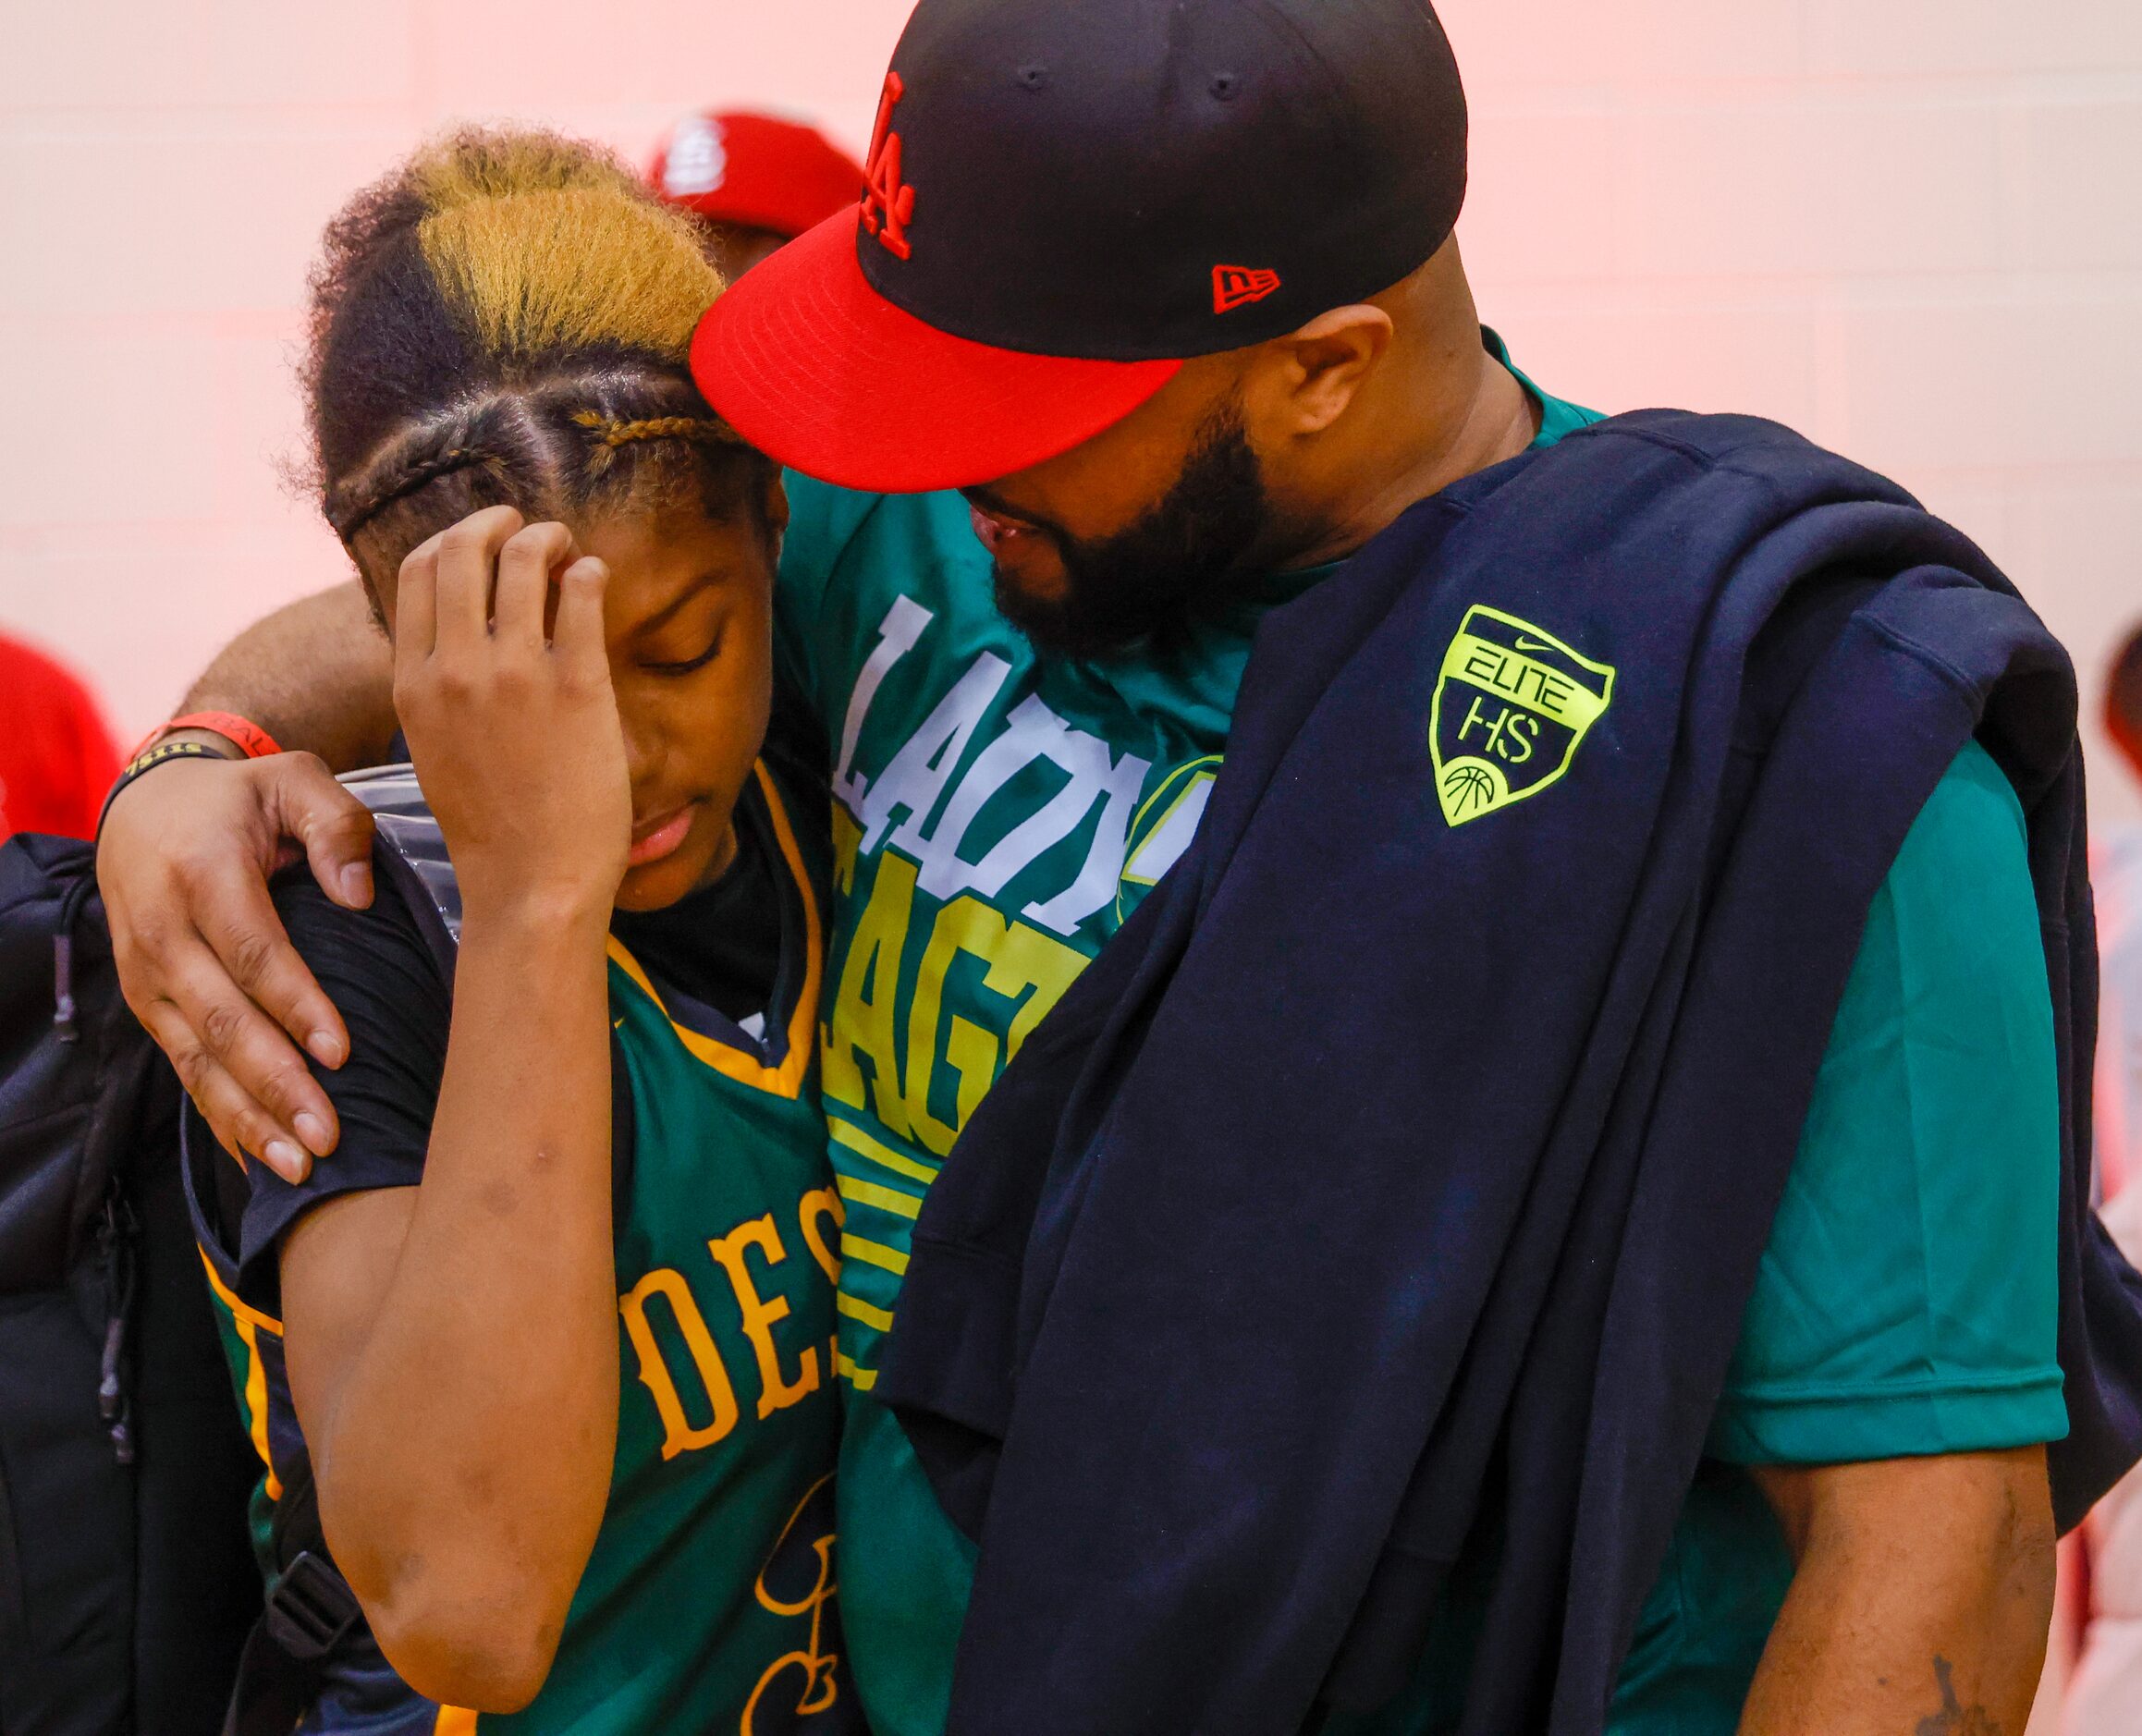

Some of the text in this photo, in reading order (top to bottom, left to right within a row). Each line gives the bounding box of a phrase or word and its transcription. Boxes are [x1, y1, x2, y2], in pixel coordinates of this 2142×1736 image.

[1463, 644, 1575, 715] ELITE
[831, 593, 1152, 937] LADY
[1457, 695, 1539, 764] HS
